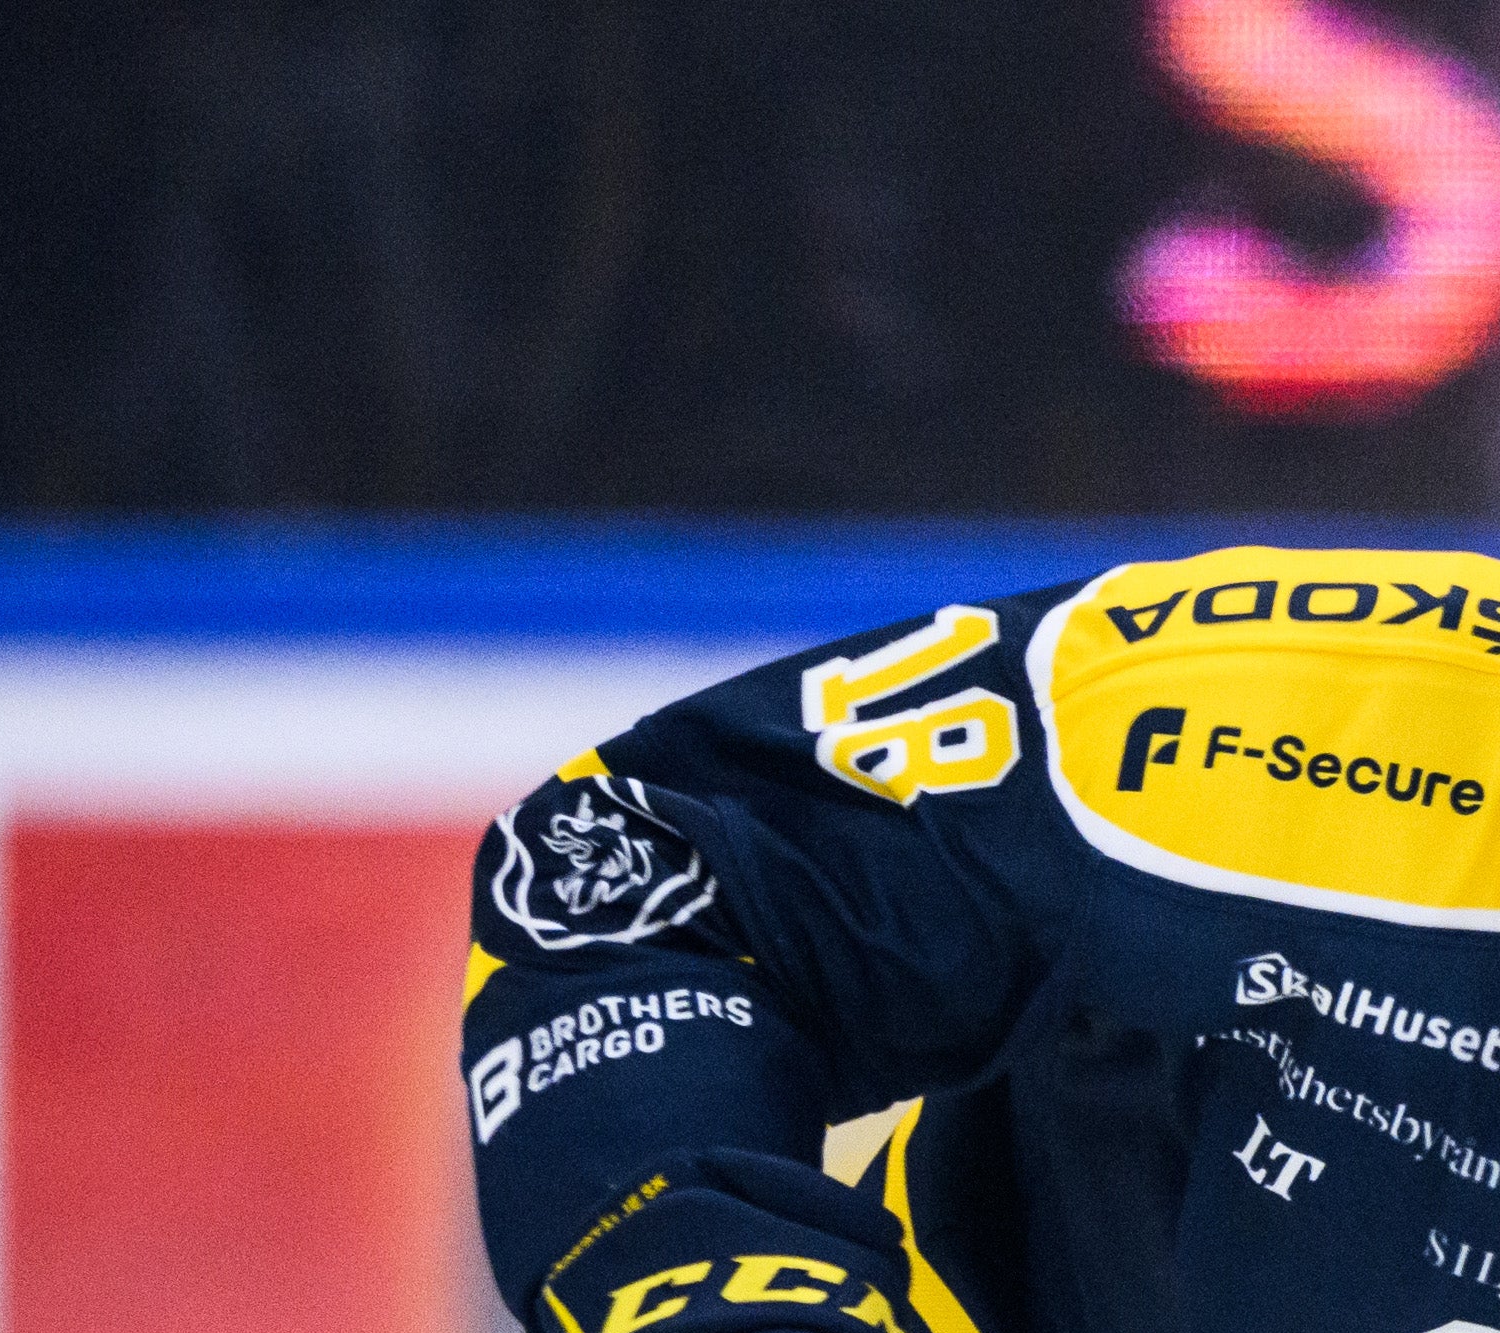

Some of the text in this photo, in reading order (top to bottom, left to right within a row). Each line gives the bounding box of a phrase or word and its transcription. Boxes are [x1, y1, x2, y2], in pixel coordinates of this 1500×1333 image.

[801, 602, 1022, 809] 18
[1202, 725, 1486, 816] F-Secure
[526, 1020, 666, 1094] CARGO
[529, 987, 755, 1061] BROTHERS
[1232, 1112, 1327, 1201] LT
